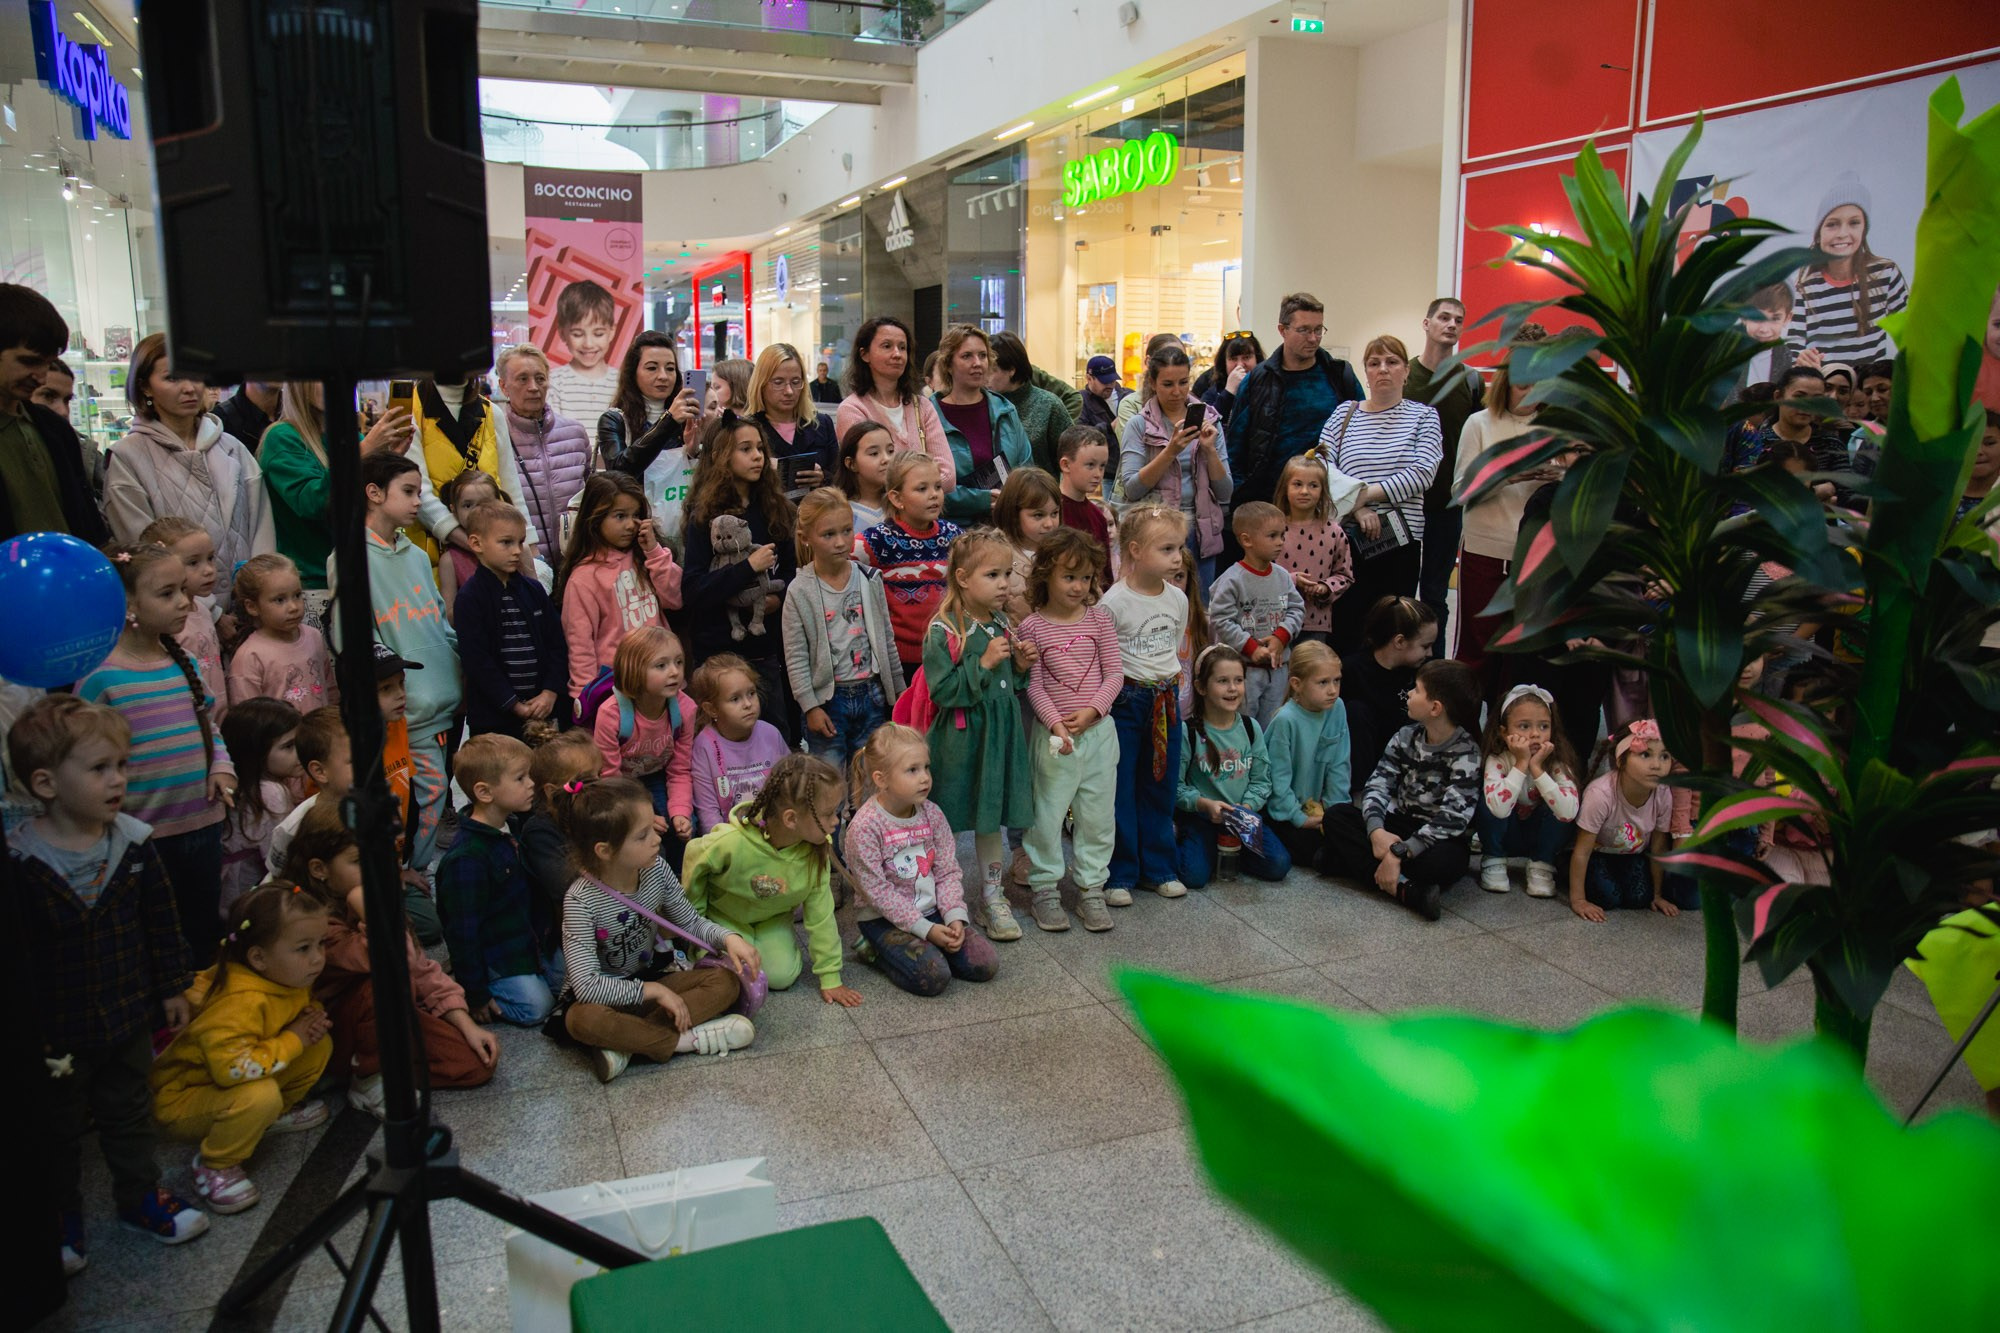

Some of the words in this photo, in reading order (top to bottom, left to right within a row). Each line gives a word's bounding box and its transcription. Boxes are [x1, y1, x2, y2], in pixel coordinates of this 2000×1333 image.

[49, 0, 131, 140] kapika
[534, 183, 633, 201] BOCCONCINO
[1062, 131, 1178, 207] SABOO
[885, 229, 914, 252] adidas
